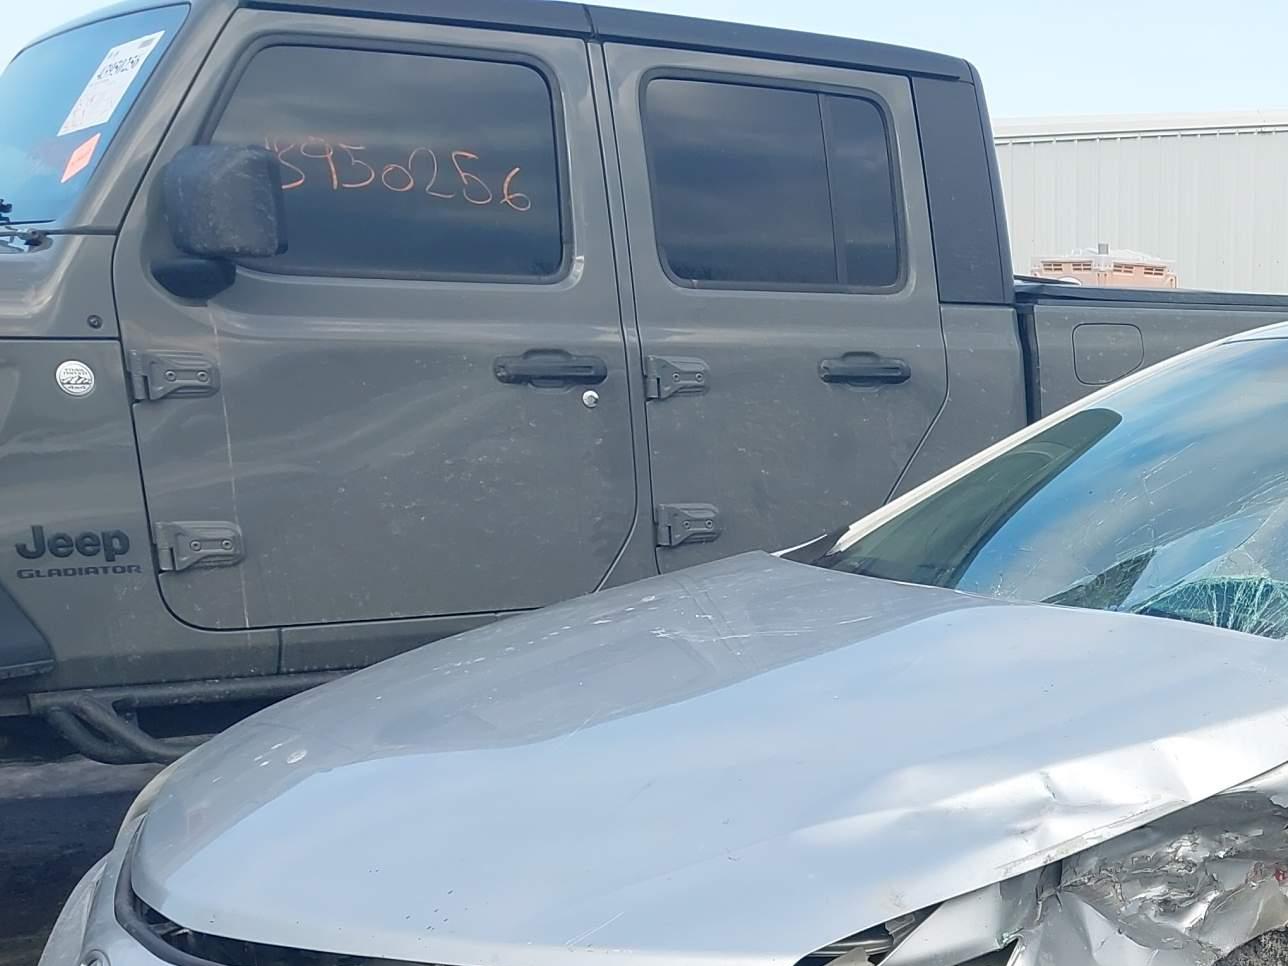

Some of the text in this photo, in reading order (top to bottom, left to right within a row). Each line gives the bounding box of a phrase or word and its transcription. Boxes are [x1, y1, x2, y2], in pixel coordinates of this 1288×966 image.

[265, 136, 531, 211] 3950256
[15, 525, 130, 562] Jeep
[16, 564, 142, 579] GLADIATOR
